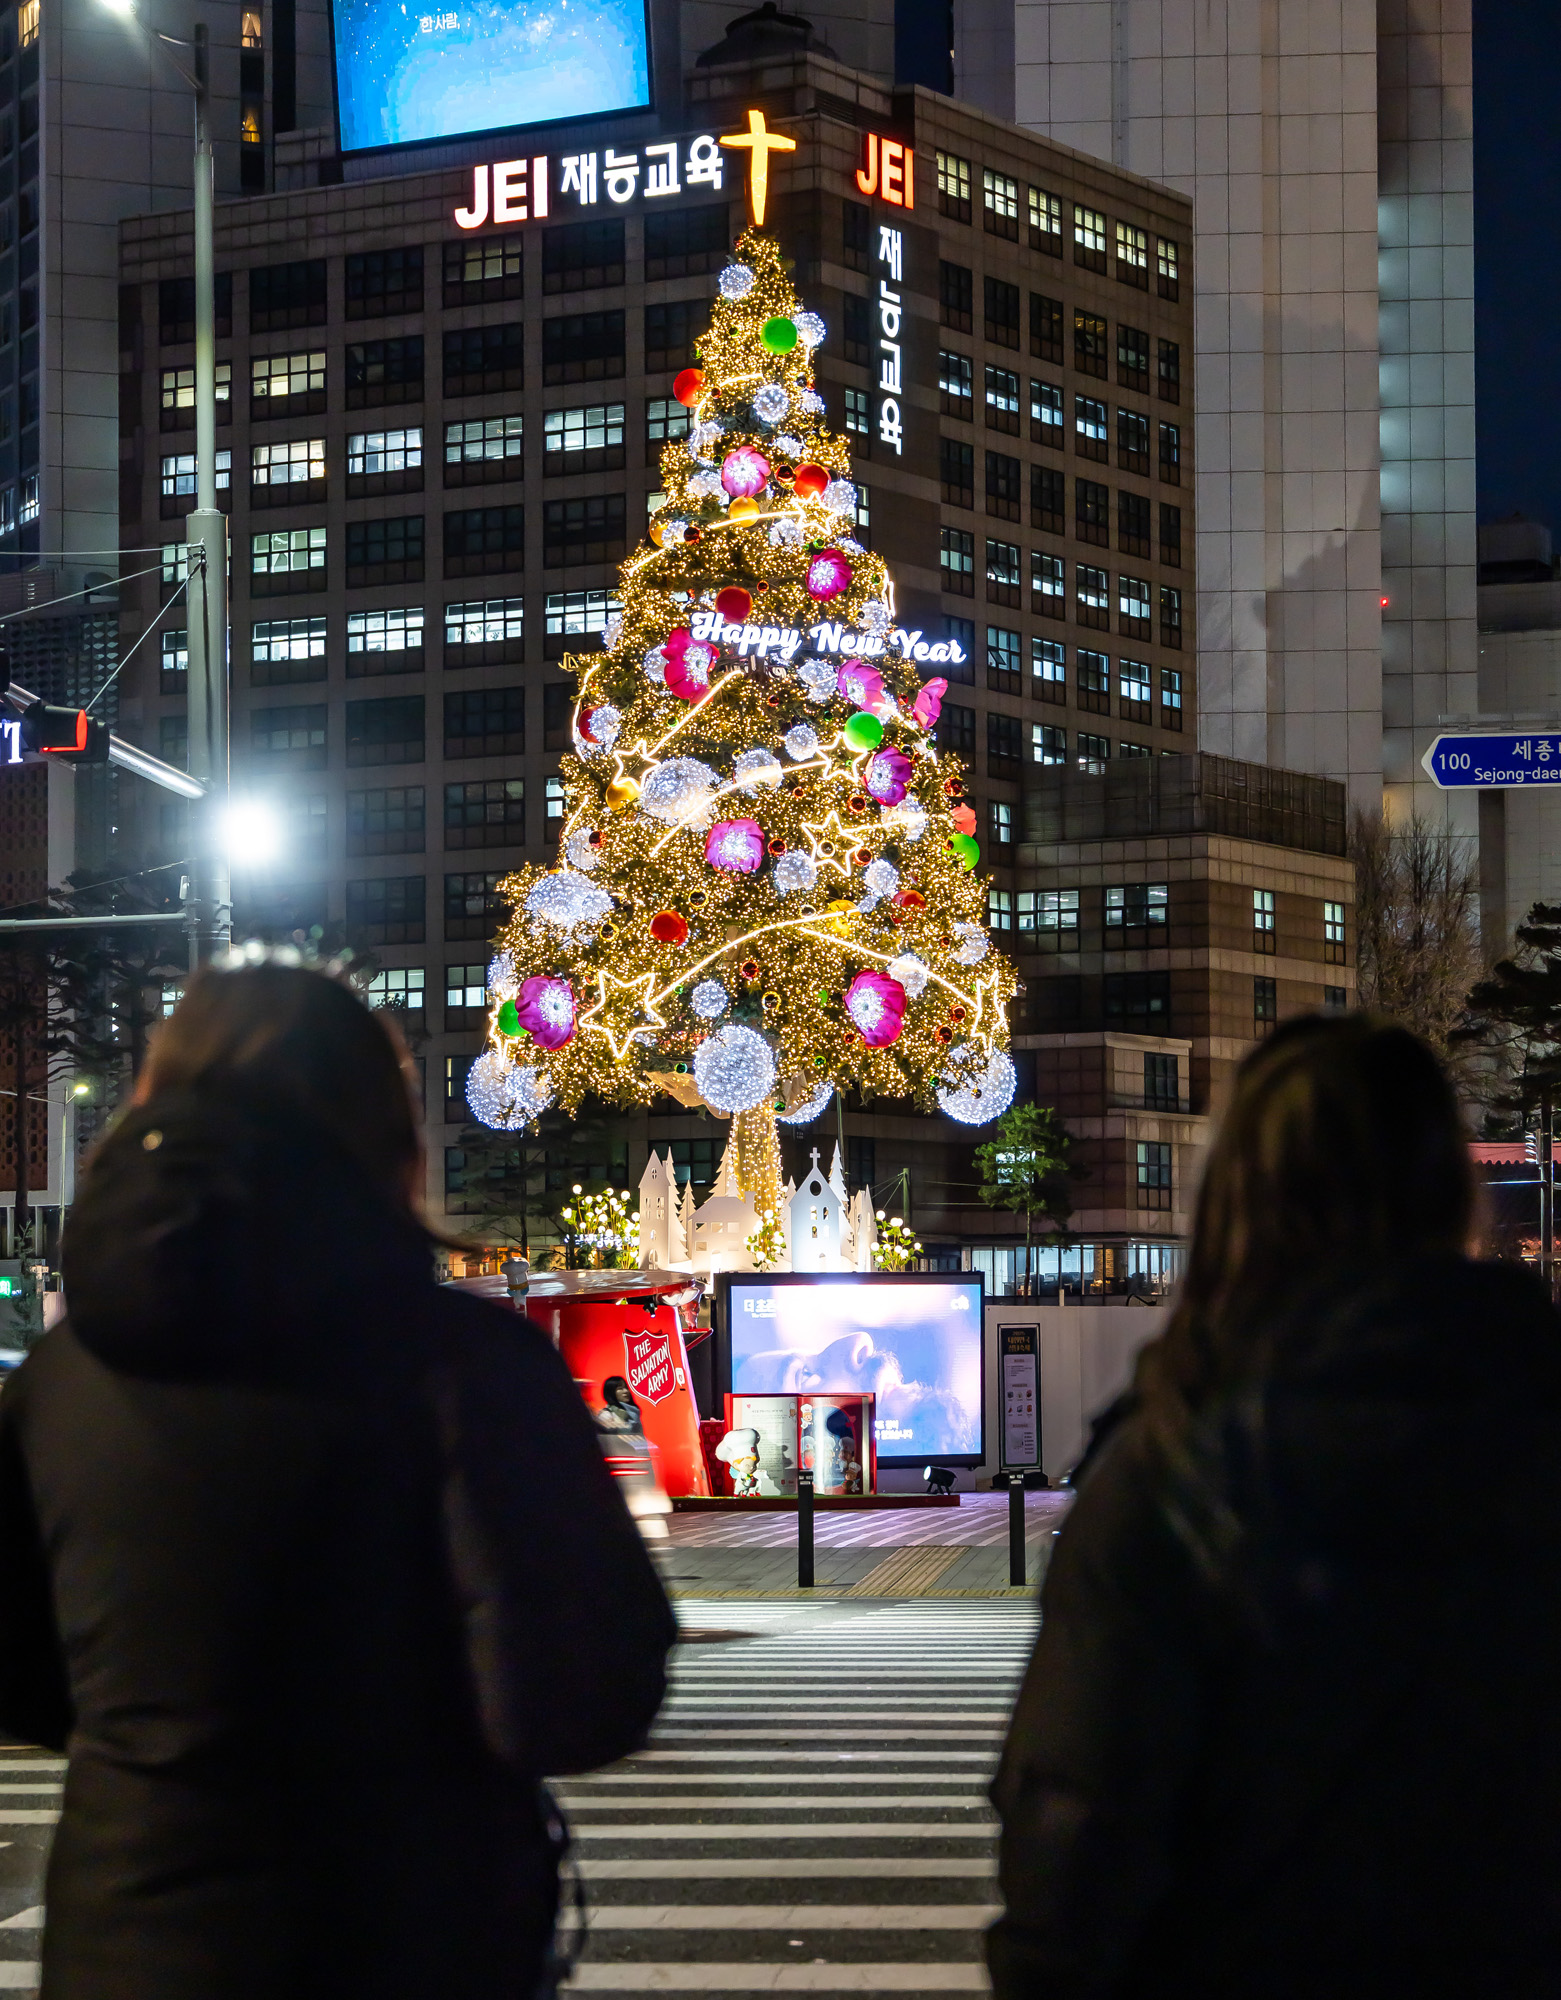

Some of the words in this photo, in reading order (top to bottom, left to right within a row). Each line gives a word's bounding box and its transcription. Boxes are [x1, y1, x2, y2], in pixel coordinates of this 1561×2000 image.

[419, 15, 433, 33] 한
[454, 156, 548, 229] JEI
[560, 134, 724, 206] 재능교육
[856, 133, 914, 210] JEI
[878, 225, 903, 456] 재능교육
[690, 611, 802, 659] Happy
[809, 621, 886, 656] New
[889, 629, 968, 663] Year
[1439, 753, 1471, 770] 100
[1511, 740, 1561, 762] 세종
[630, 1341, 669, 1387] SALVATION
[633, 1338, 652, 1362] THE
[648, 1363, 669, 1397] ARMY
